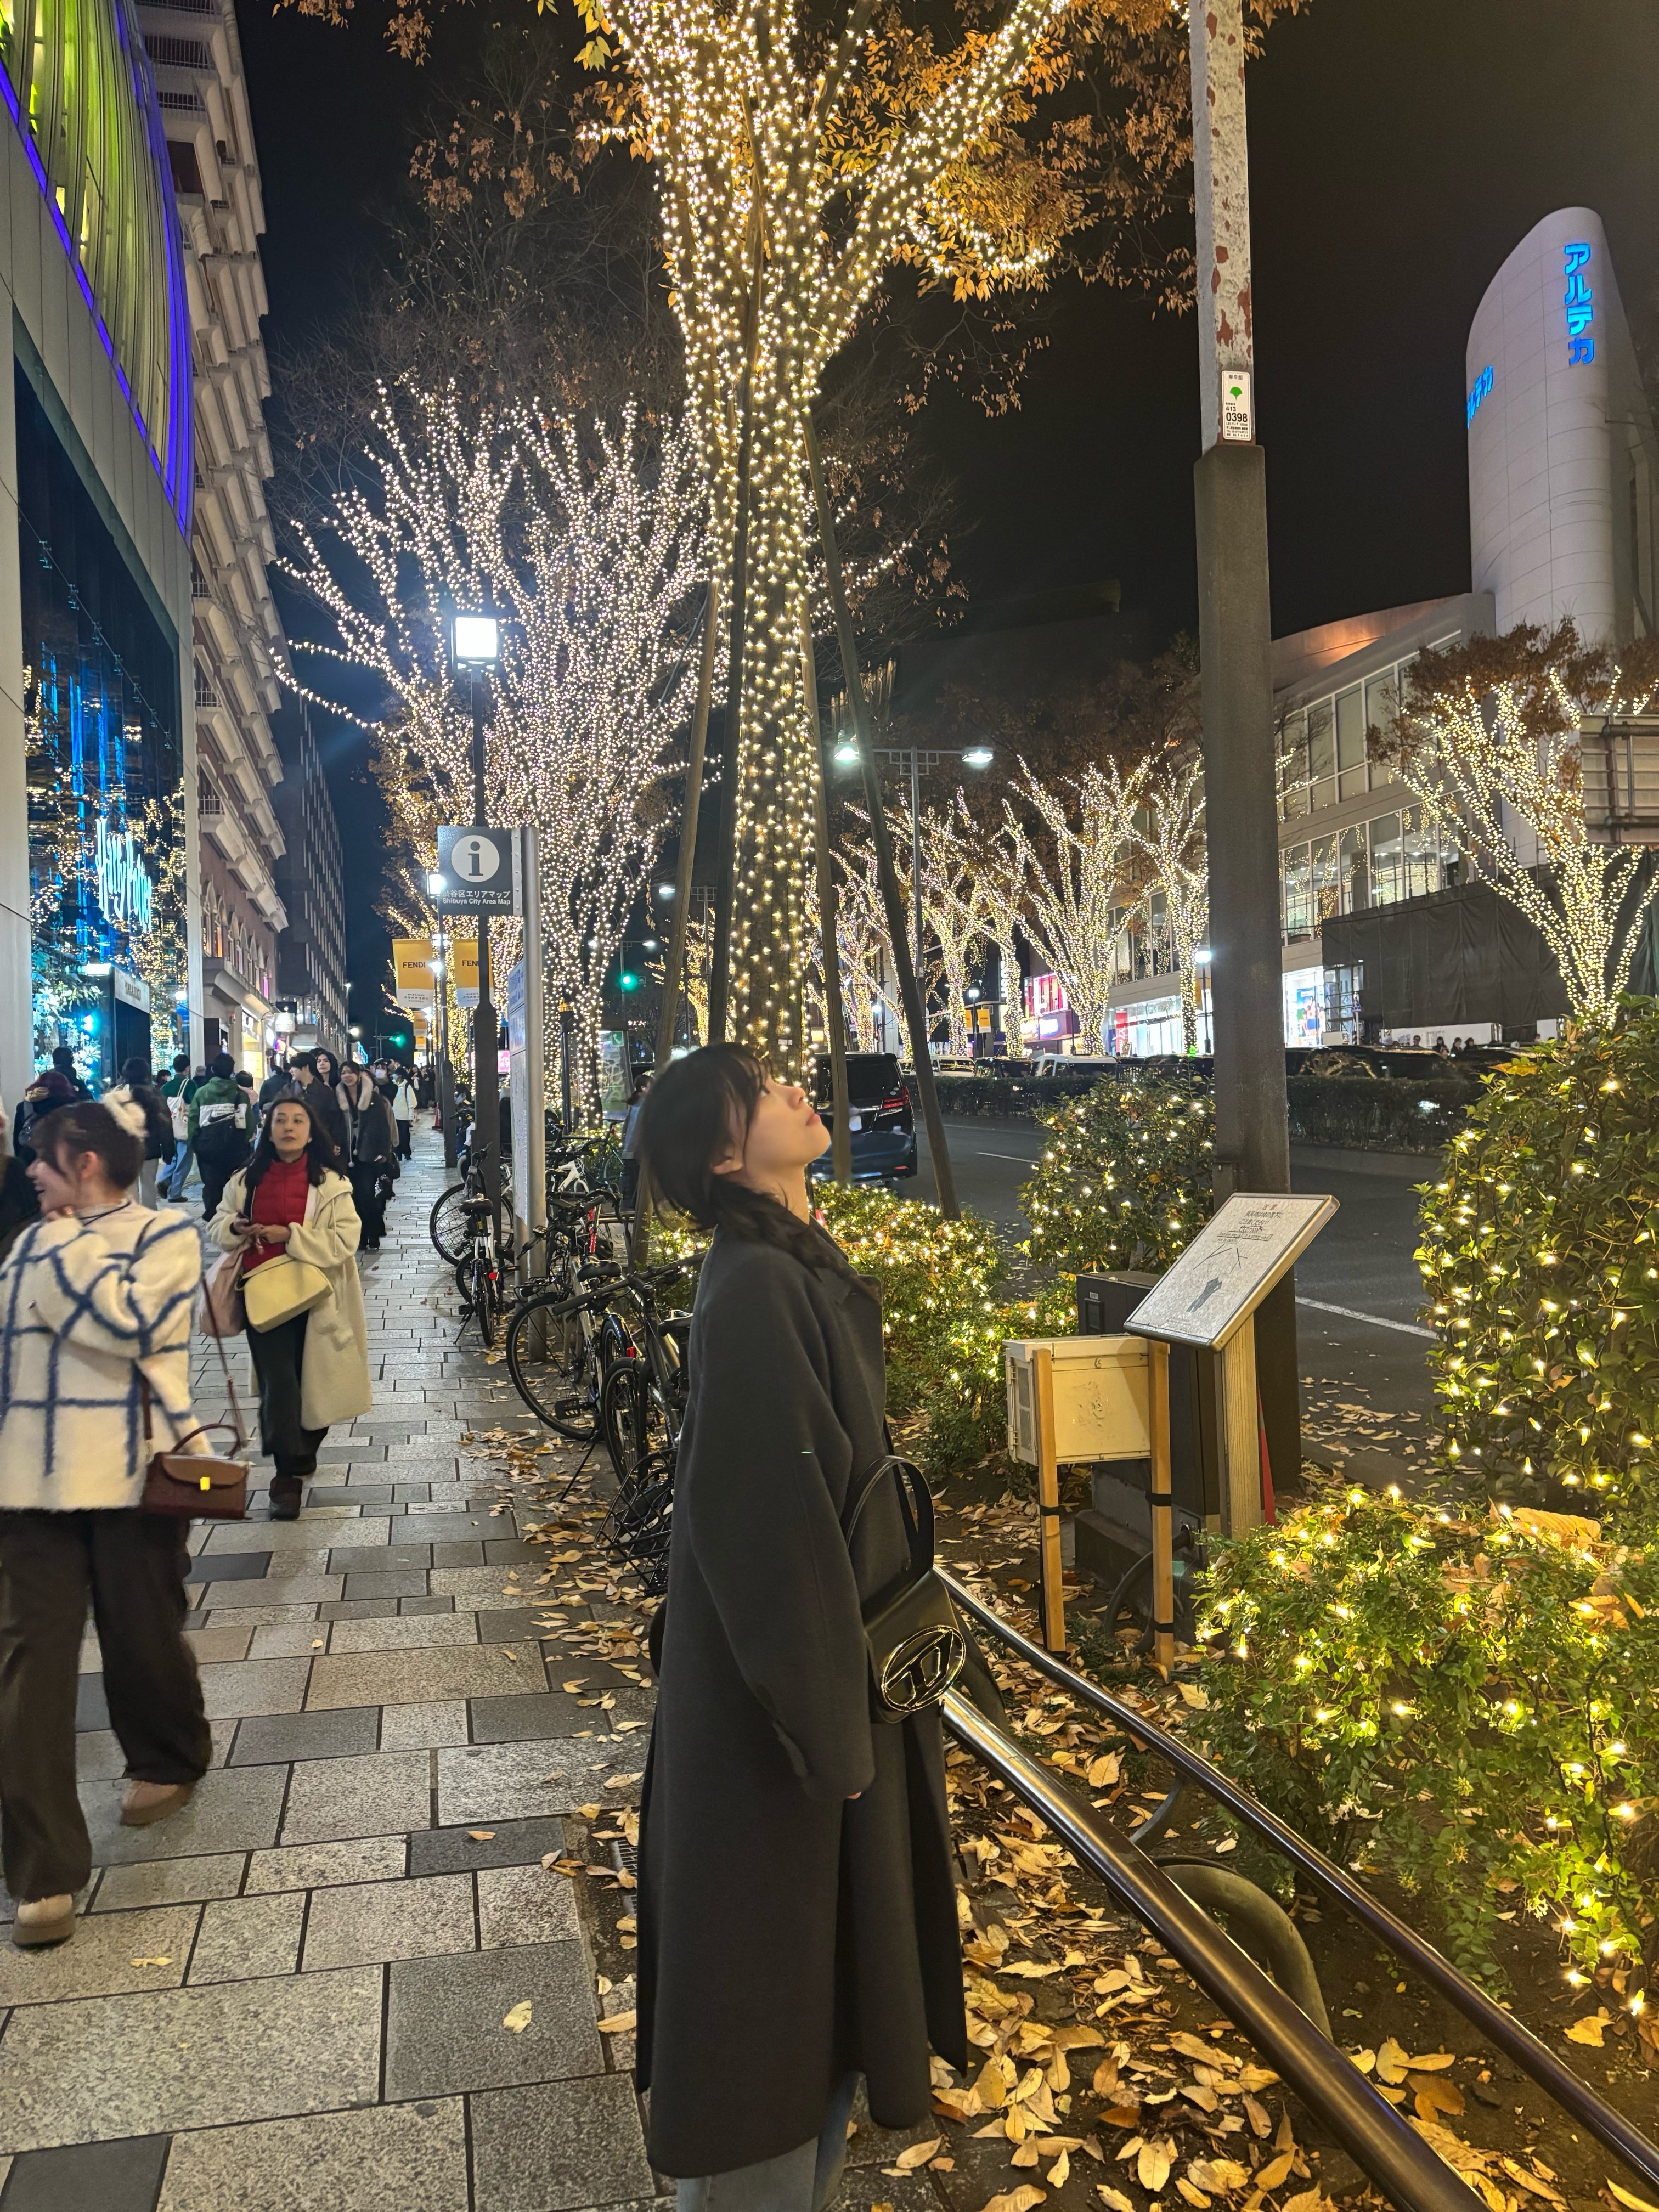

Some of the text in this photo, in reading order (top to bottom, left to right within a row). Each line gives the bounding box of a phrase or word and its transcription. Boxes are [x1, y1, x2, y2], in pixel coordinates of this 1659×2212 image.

[1564, 243, 1595, 366] アルテカ
[1226, 413, 1248, 422] 0398
[442, 890, 511, 898] 渋谷区エリアマップ
